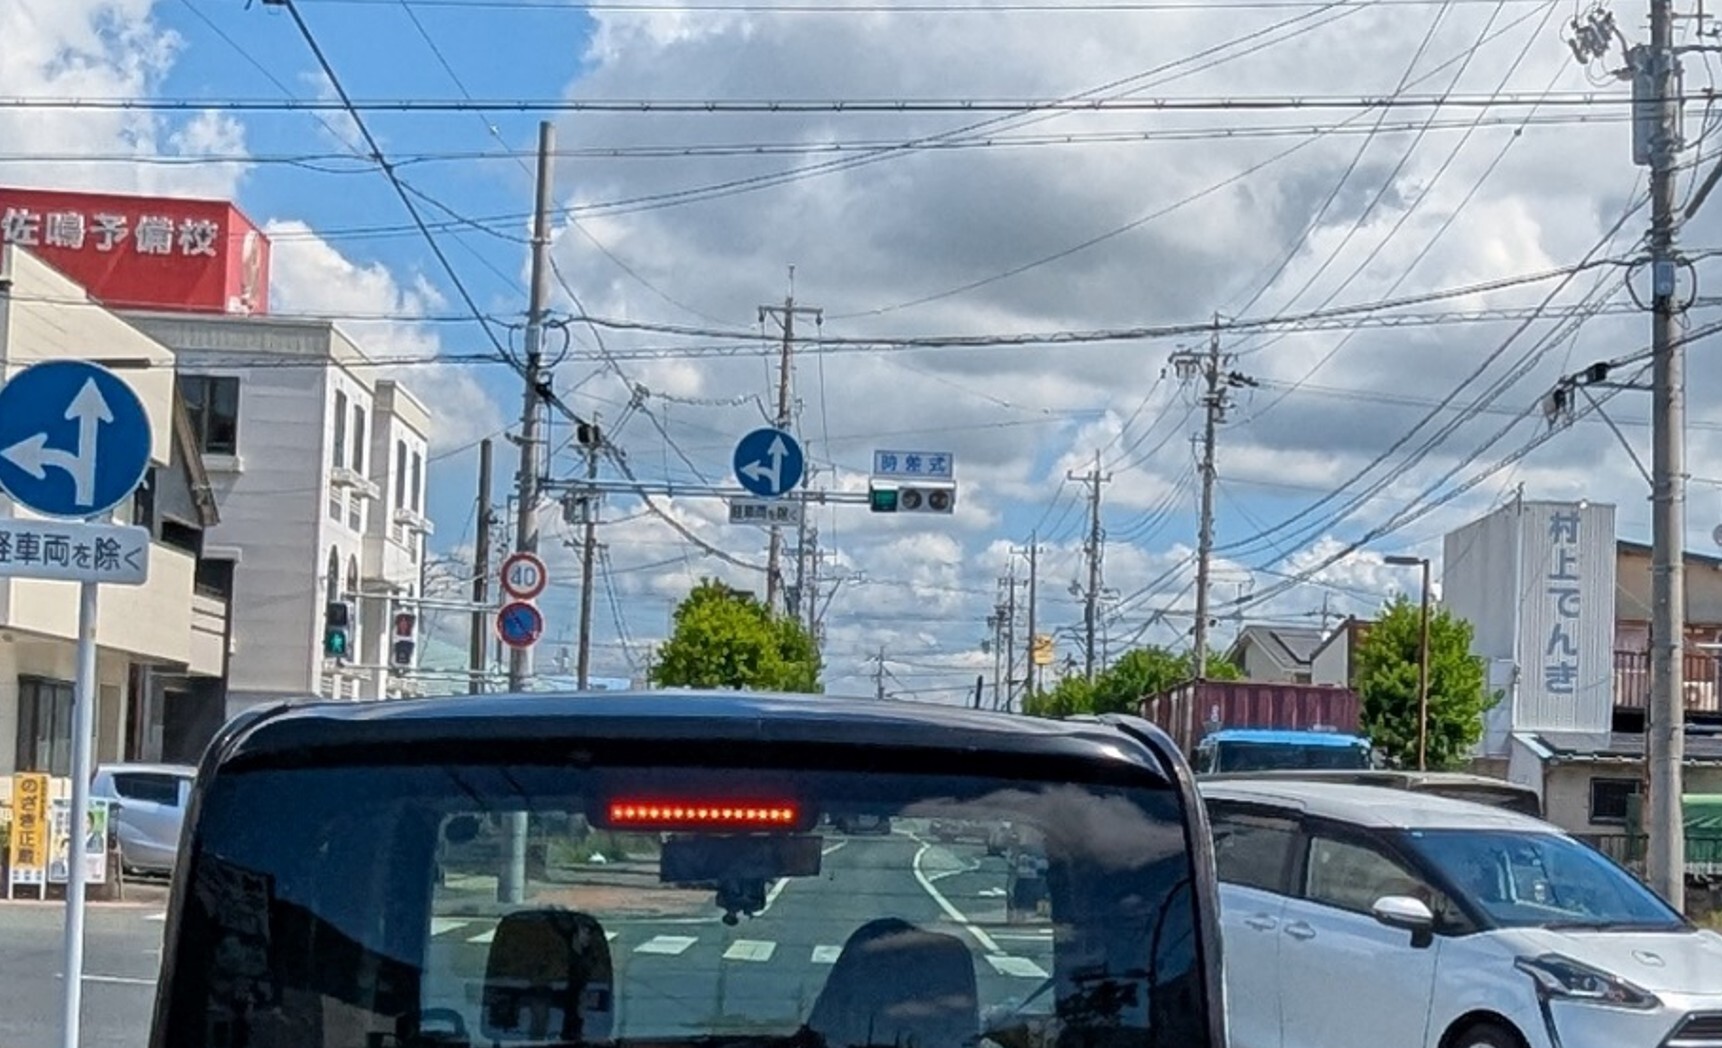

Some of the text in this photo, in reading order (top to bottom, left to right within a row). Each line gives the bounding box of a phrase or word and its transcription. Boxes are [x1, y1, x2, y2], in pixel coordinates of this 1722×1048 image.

[1, 207, 218, 256] 佐鳴予備校
[510, 566, 537, 586] 40
[1545, 511, 1581, 694] 村上でんき
